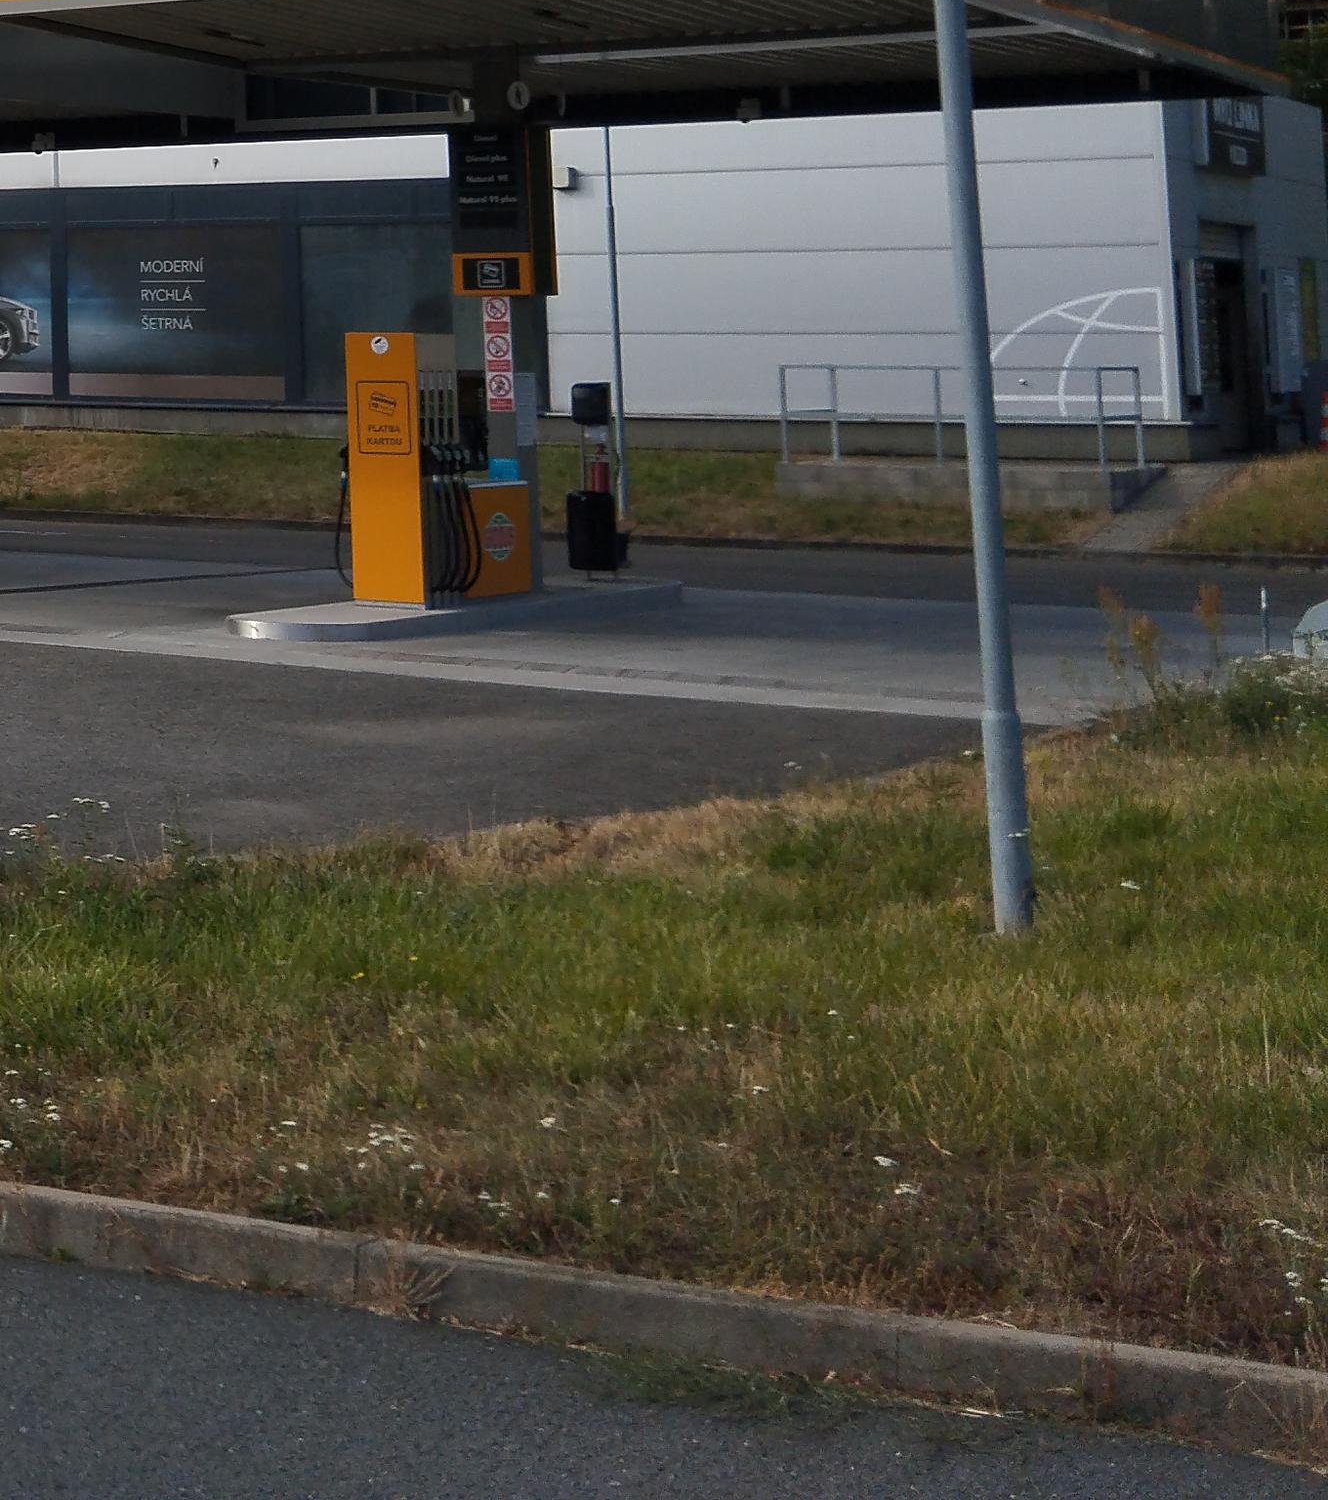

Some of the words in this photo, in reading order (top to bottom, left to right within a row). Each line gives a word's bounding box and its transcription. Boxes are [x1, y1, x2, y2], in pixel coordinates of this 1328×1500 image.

[139, 256, 204, 273] MODERNÍ
[140, 285, 193, 302] RYCHLÁ
[140, 314, 194, 330] ŠETRNÁ
